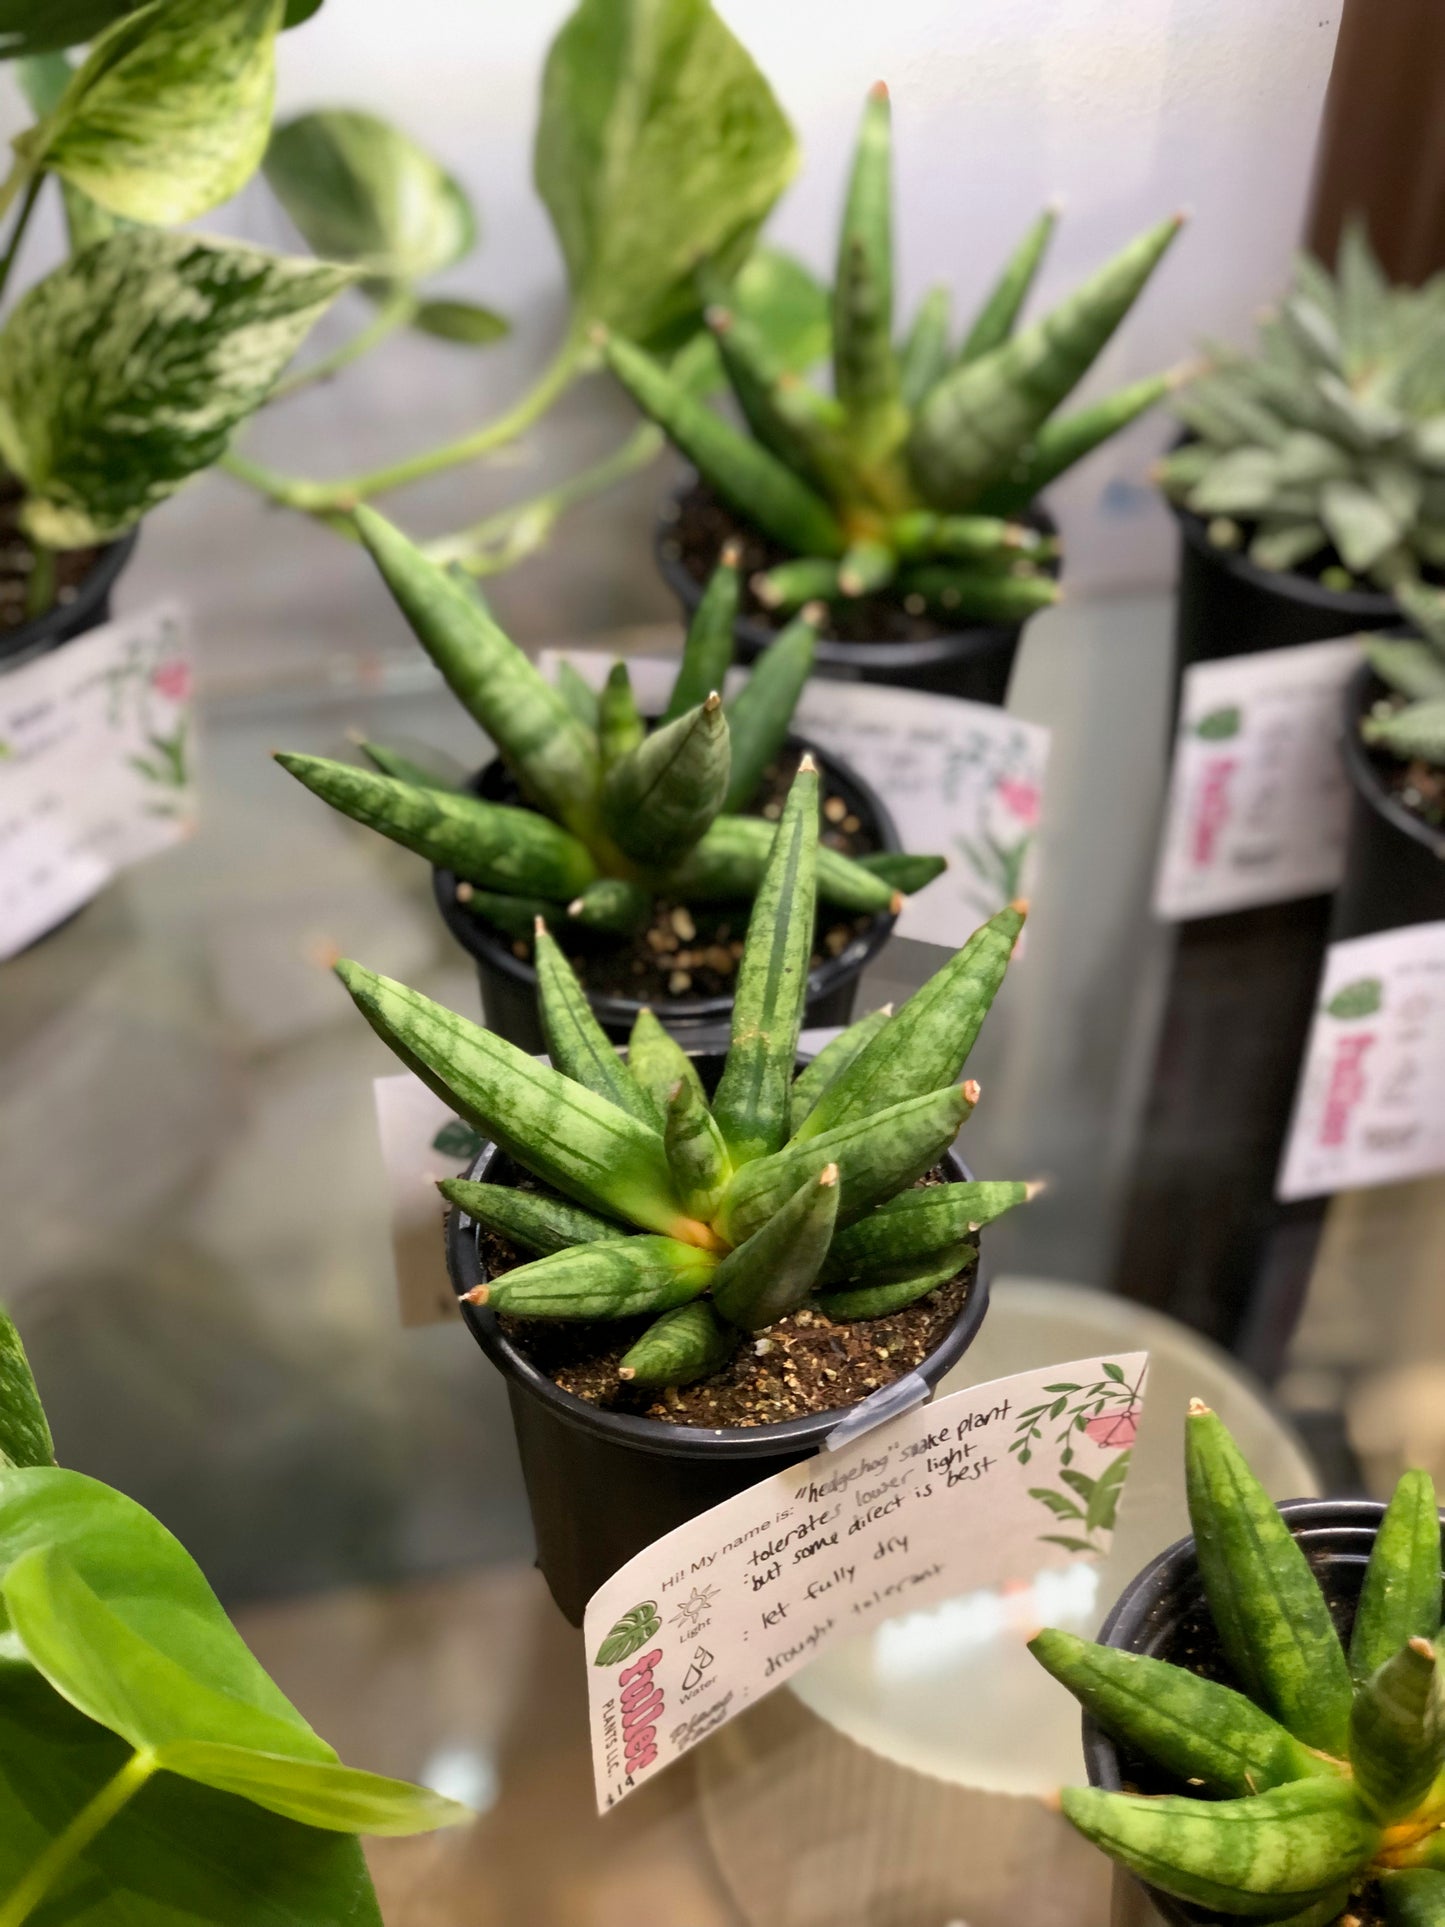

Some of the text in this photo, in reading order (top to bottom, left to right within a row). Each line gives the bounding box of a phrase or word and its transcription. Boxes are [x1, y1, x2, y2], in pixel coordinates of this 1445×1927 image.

[957, 1399, 1013, 1441] plant
[746, 1442, 978, 1567] tolerates lower light
[751, 1456, 998, 1592] but some direct is best
[661, 1507, 795, 1592] Hi! My name is:
[761, 1535, 909, 1630] let fully dry
[679, 1617, 713, 1644] Light
[764, 1617, 836, 1678] drought
[601, 1698, 619, 1753] PLANTS
[618, 1648, 665, 1775] fuller
[679, 1674, 718, 1706] Water
